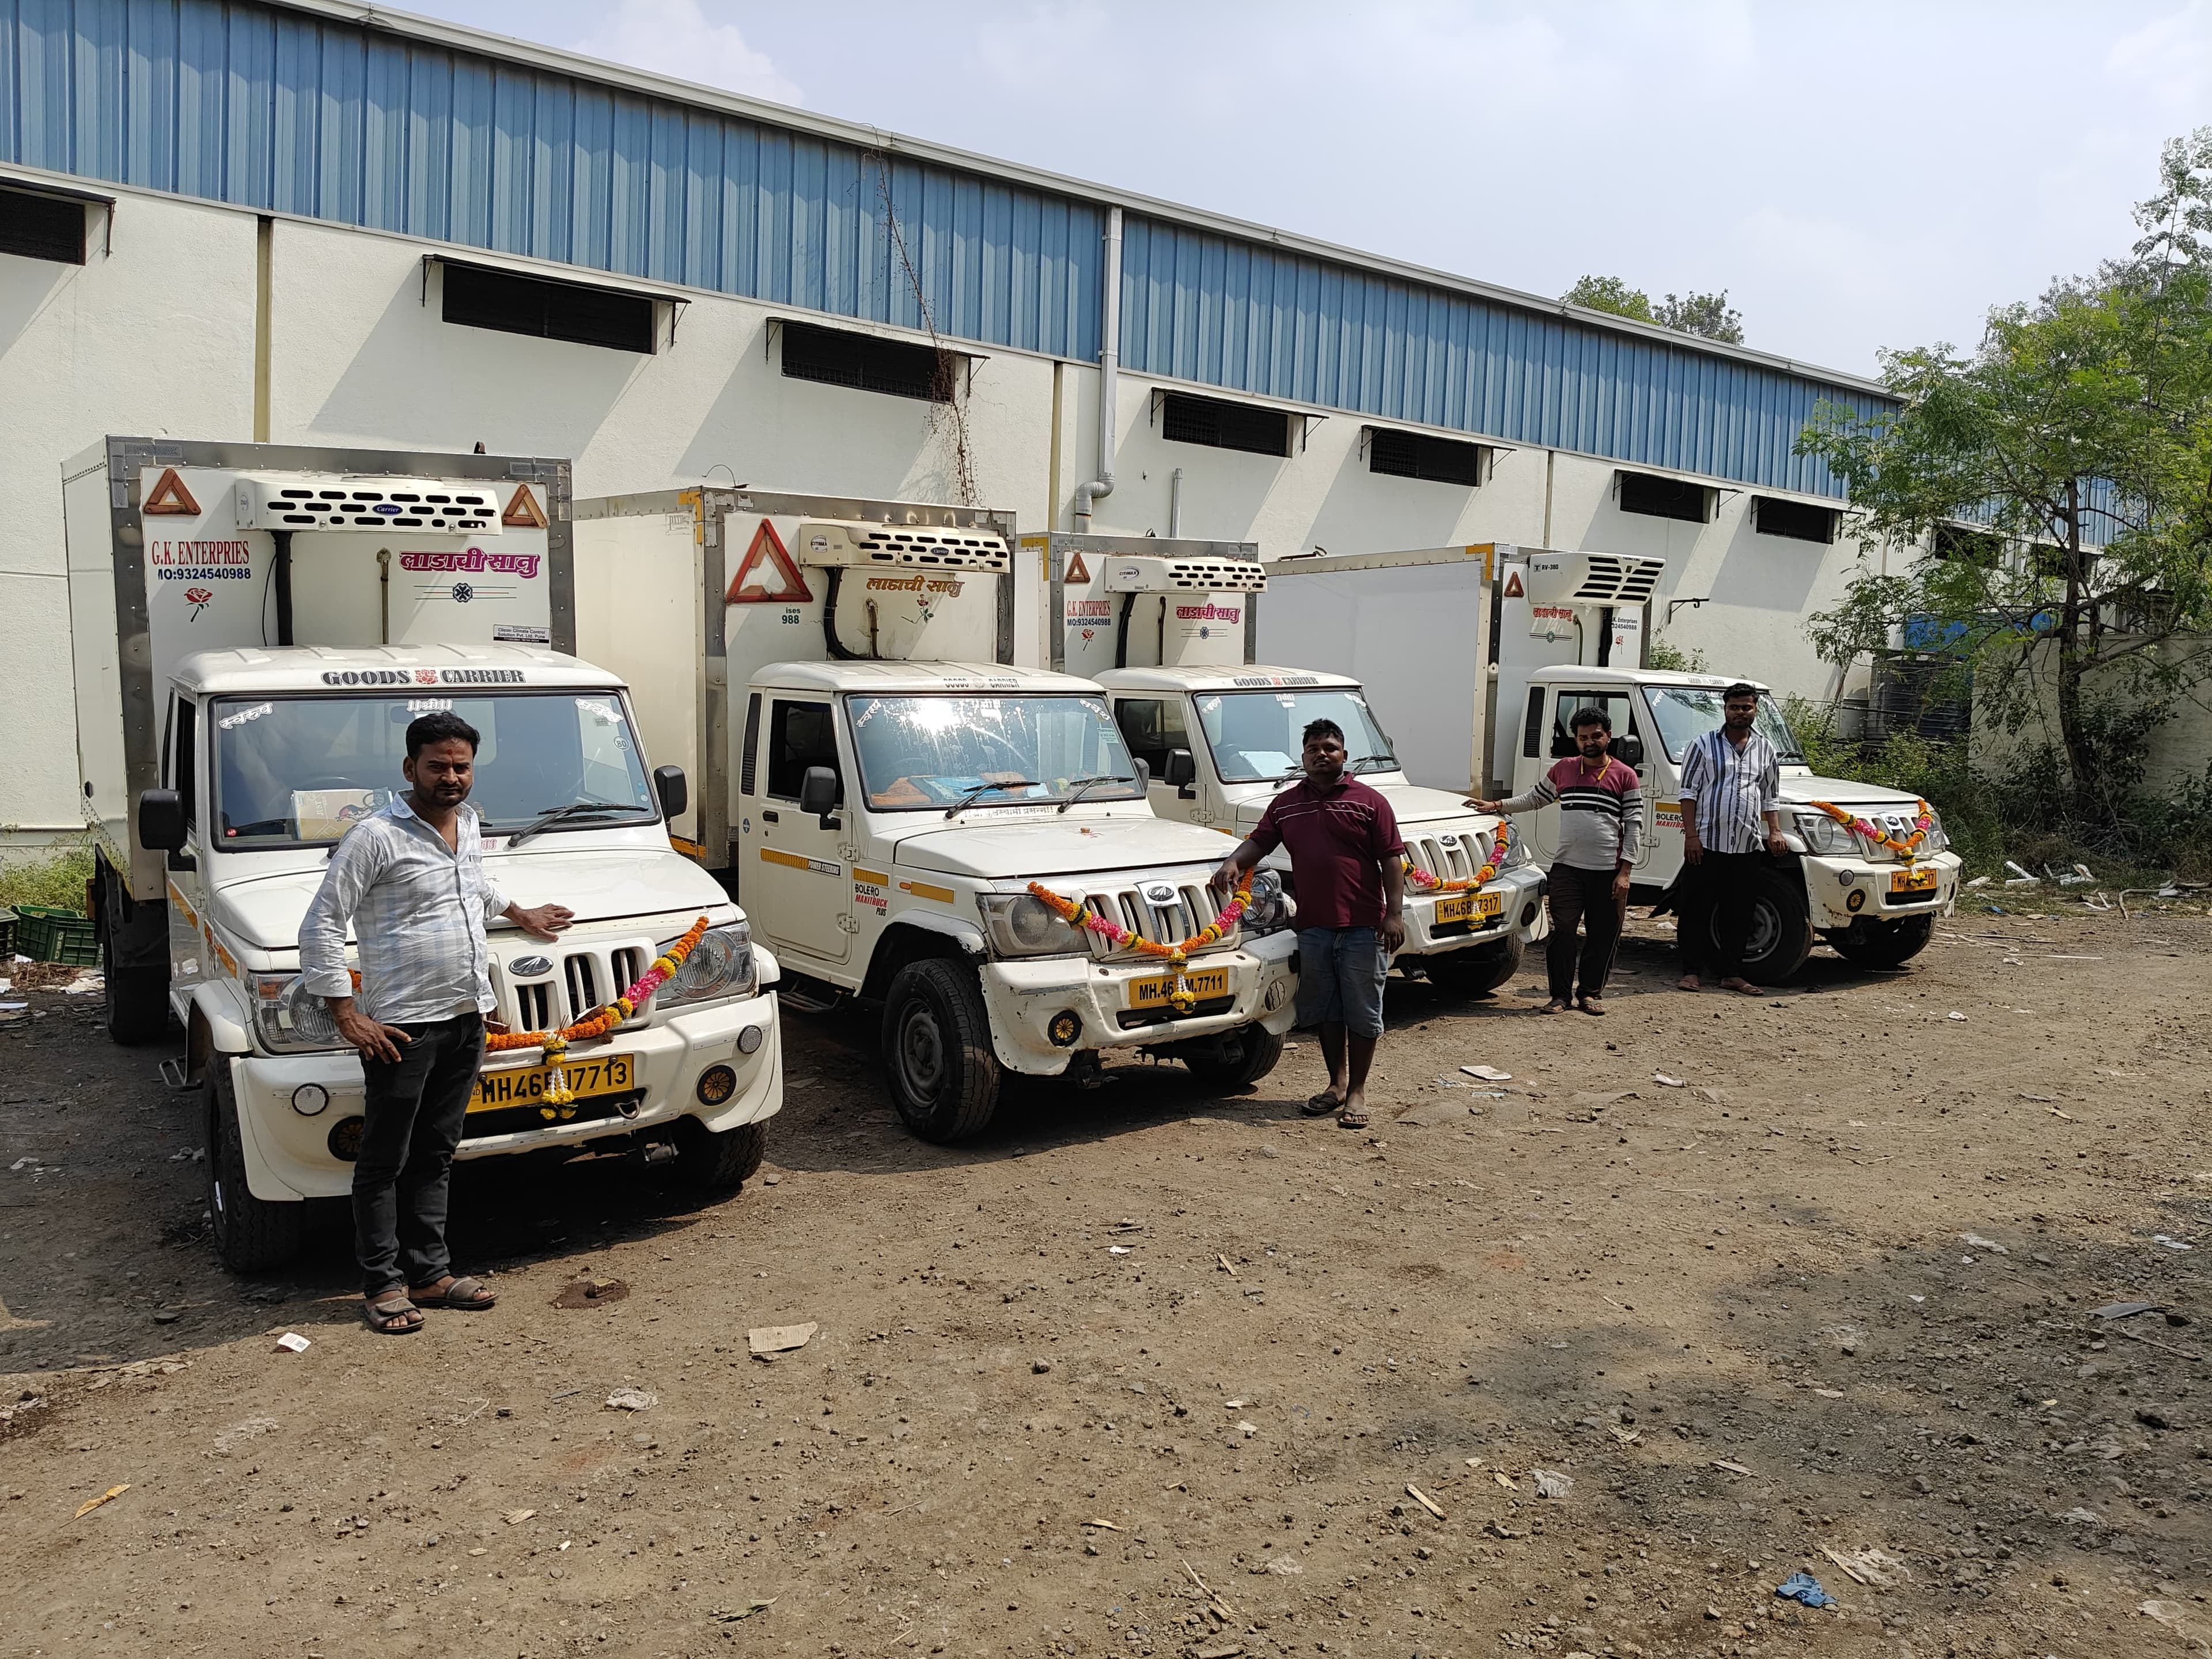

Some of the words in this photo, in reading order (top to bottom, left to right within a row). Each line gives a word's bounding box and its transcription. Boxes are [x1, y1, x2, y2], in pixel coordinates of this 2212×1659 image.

[151, 541, 176, 565] G.K.
[177, 540, 250, 565] ENTERPRIES
[399, 546, 487, 573] लाडाची
[866, 575, 925, 592] लाडाची
[1067, 600, 1077, 617] G.K.
[1078, 600, 1111, 616] ENTERPRIES
[1176, 604, 1215, 620] लाडाची
[782, 615, 800, 624] 988
[1067, 618, 1111, 626] MO:9324540988
[321, 669, 412, 686] GOODS
[439, 669, 527, 684] CARRIER
[1233, 677, 1271, 686] GOODS
[1281, 676, 1319, 685] CARRIER
[616, 740, 627, 748] 80
[808, 860, 821, 871] POWER
[821, 863, 840, 874] STEERING
[855, 883, 880, 897] BOLERO
[855, 894, 888, 908] MAXITRUCK
[1443, 897, 1498, 919] MH46B7317
[876, 907, 887, 916] PLUS
